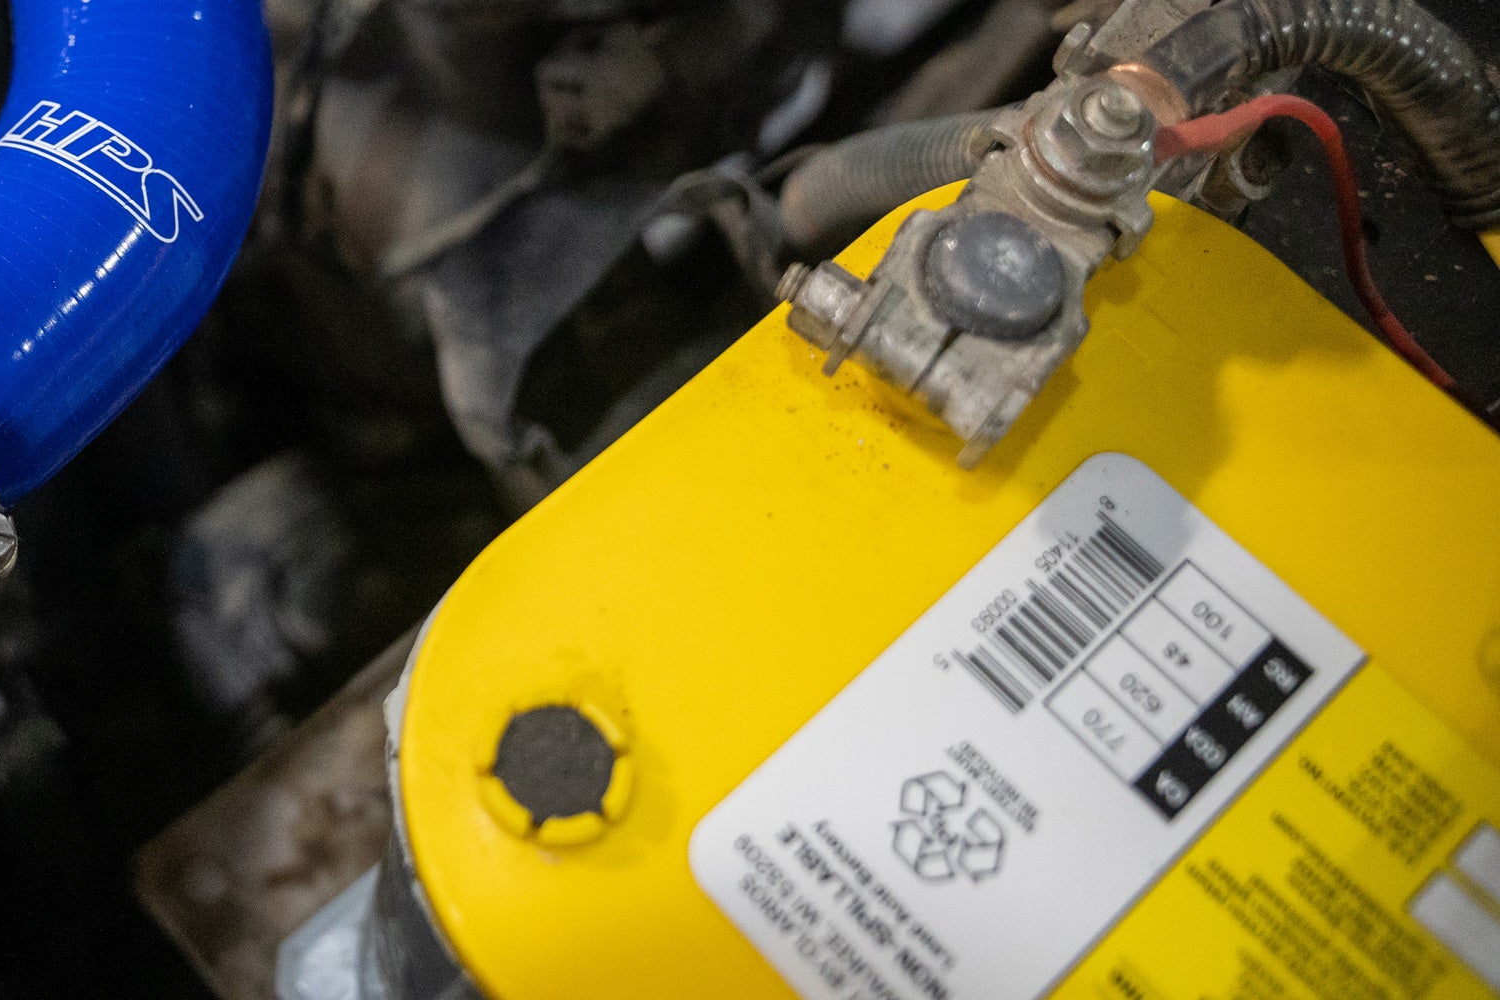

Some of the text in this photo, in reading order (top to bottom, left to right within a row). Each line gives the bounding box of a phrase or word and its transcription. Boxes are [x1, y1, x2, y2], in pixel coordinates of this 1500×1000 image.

[930, 493, 1115, 674] 8 11405 00093 5
[1189, 598, 1236, 642] 100
[1115, 670, 1165, 717] 620
[1078, 705, 1127, 753] 770
